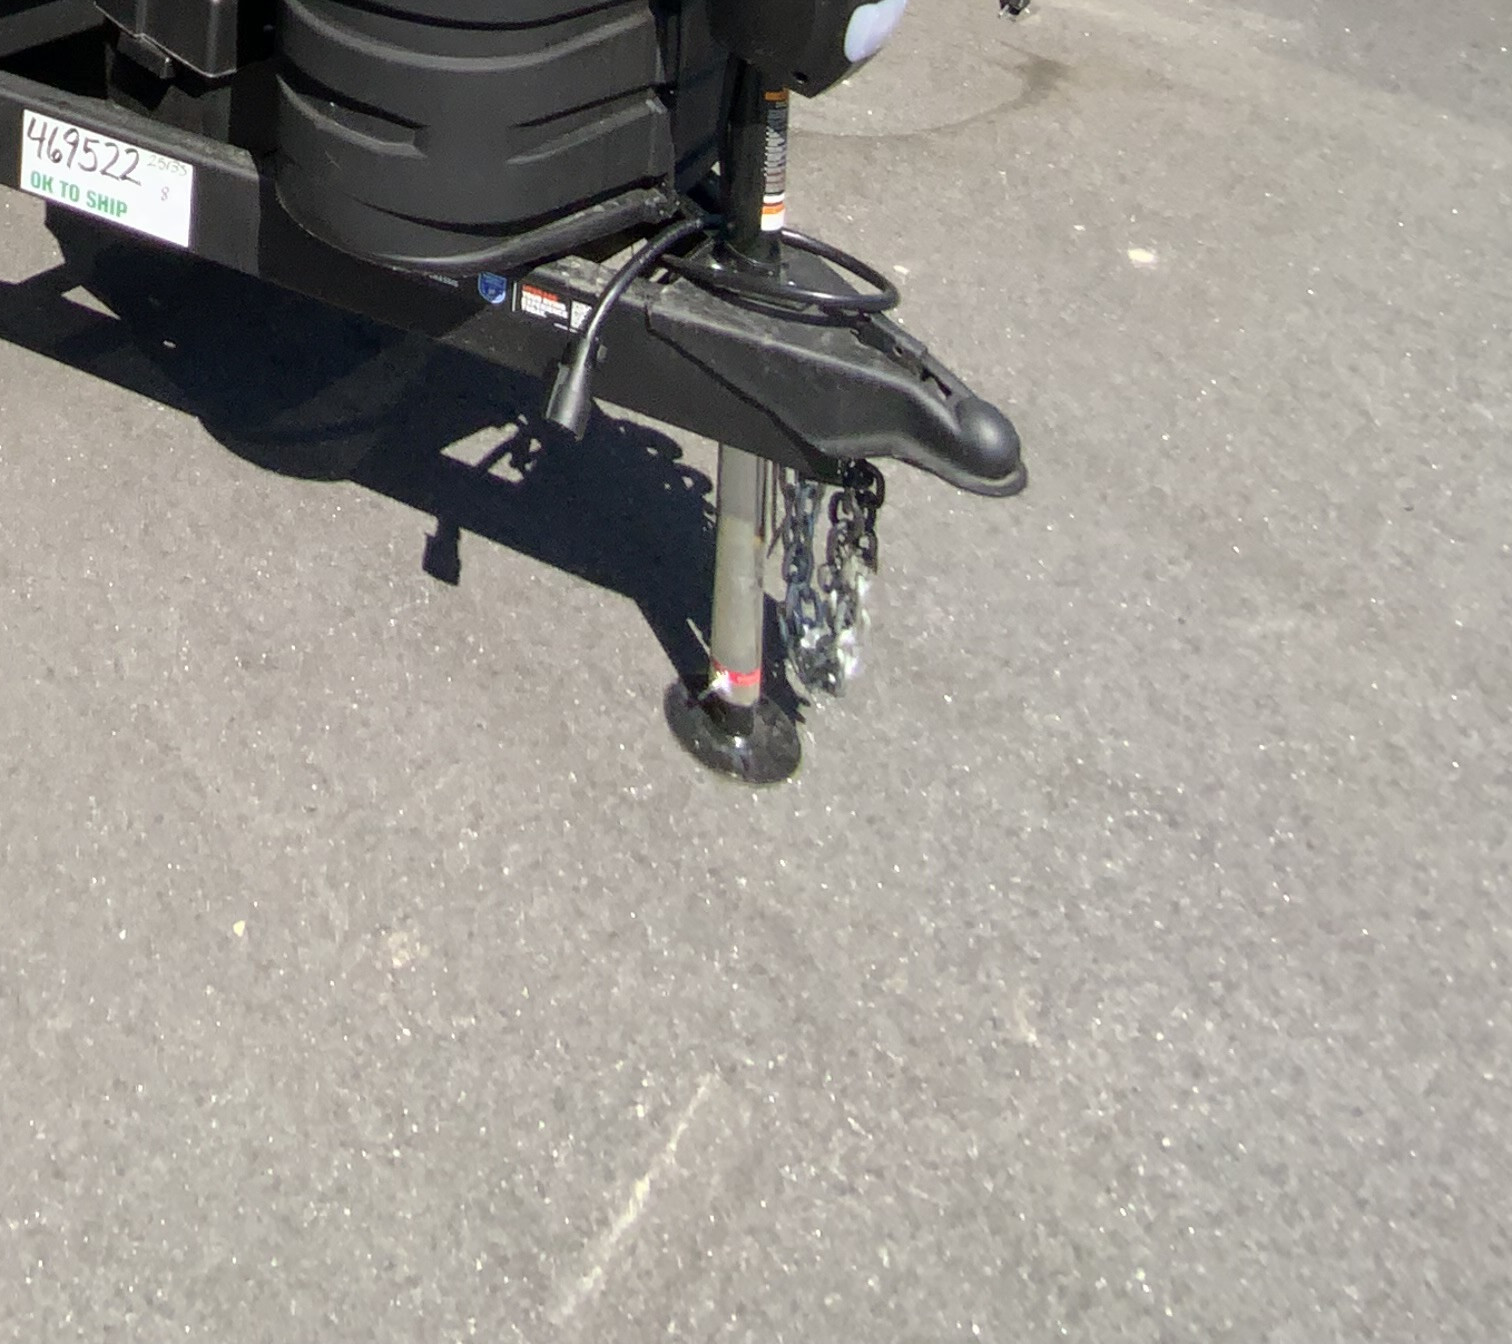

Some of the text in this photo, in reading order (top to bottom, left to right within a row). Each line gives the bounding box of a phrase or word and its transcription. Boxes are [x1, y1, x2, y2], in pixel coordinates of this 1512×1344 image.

[27, 116, 142, 187] 469522
[30, 170, 128, 218] OK TO SHIP
